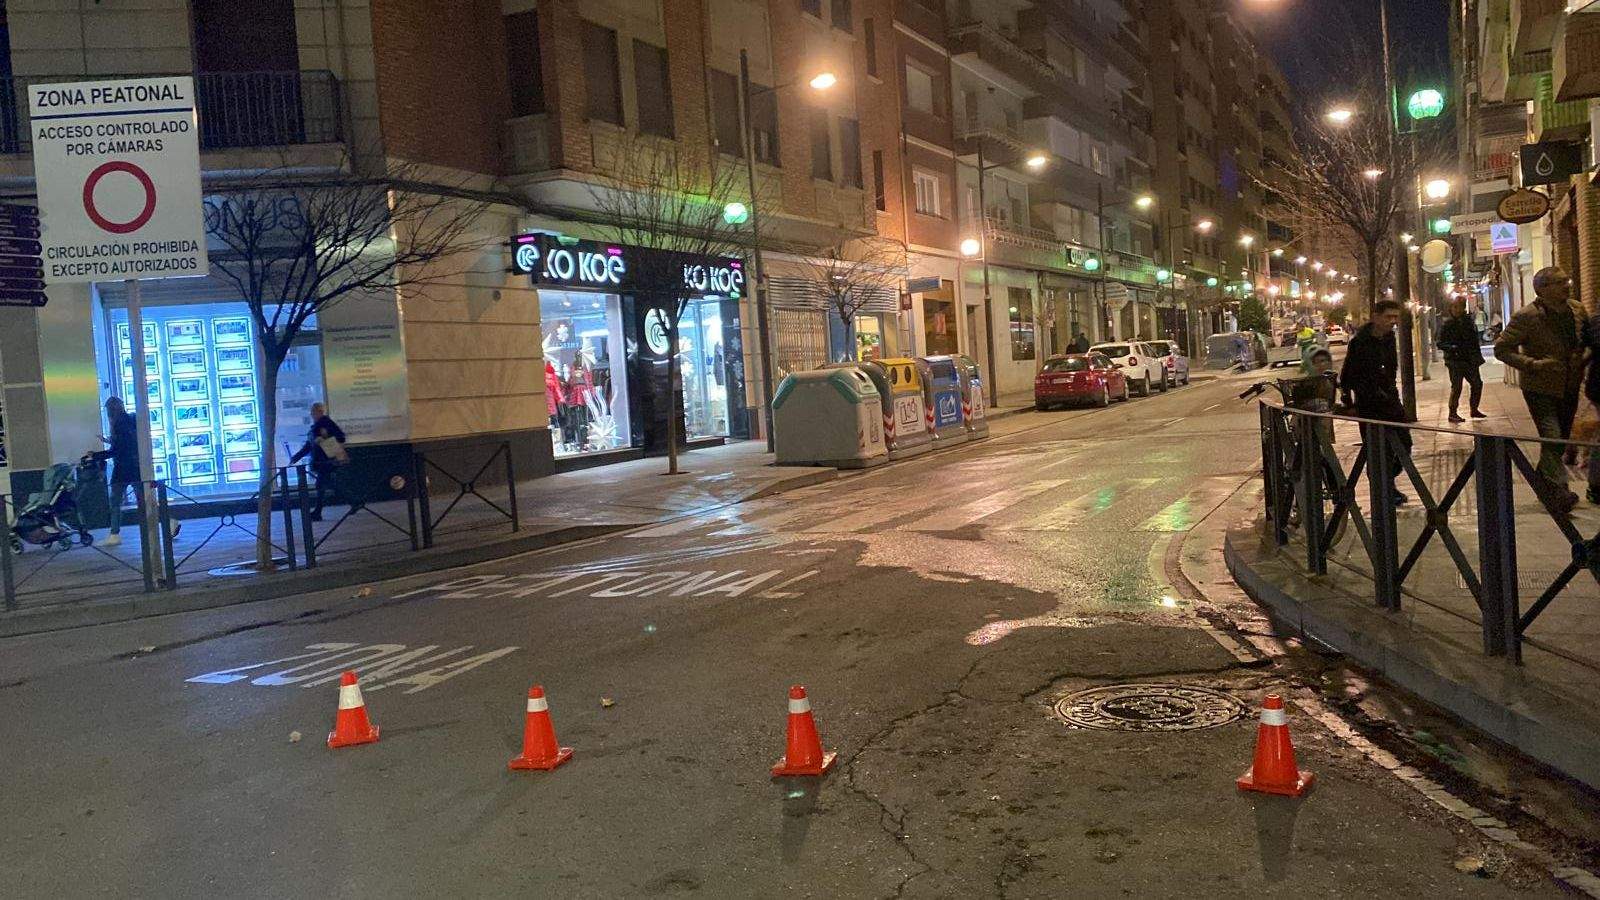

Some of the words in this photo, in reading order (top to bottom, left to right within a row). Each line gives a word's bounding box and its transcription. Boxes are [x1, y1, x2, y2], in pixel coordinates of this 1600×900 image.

[37, 90, 86, 107] ZONA
[91, 84, 184, 104] PEATONAL
[38, 125, 93, 140] ACCESO
[96, 120, 189, 137] CONTROLADO
[66, 143, 94, 156] POR
[97, 138, 164, 155] CÁMARAS
[47, 240, 130, 260] CIRCULACIÓN
[133, 240, 200, 256] PROHIBIDA
[52, 261, 109, 277] EXCEPTO
[112, 257, 198, 275] AUTORIZADOS
[185, 642, 521, 695] ZONA
